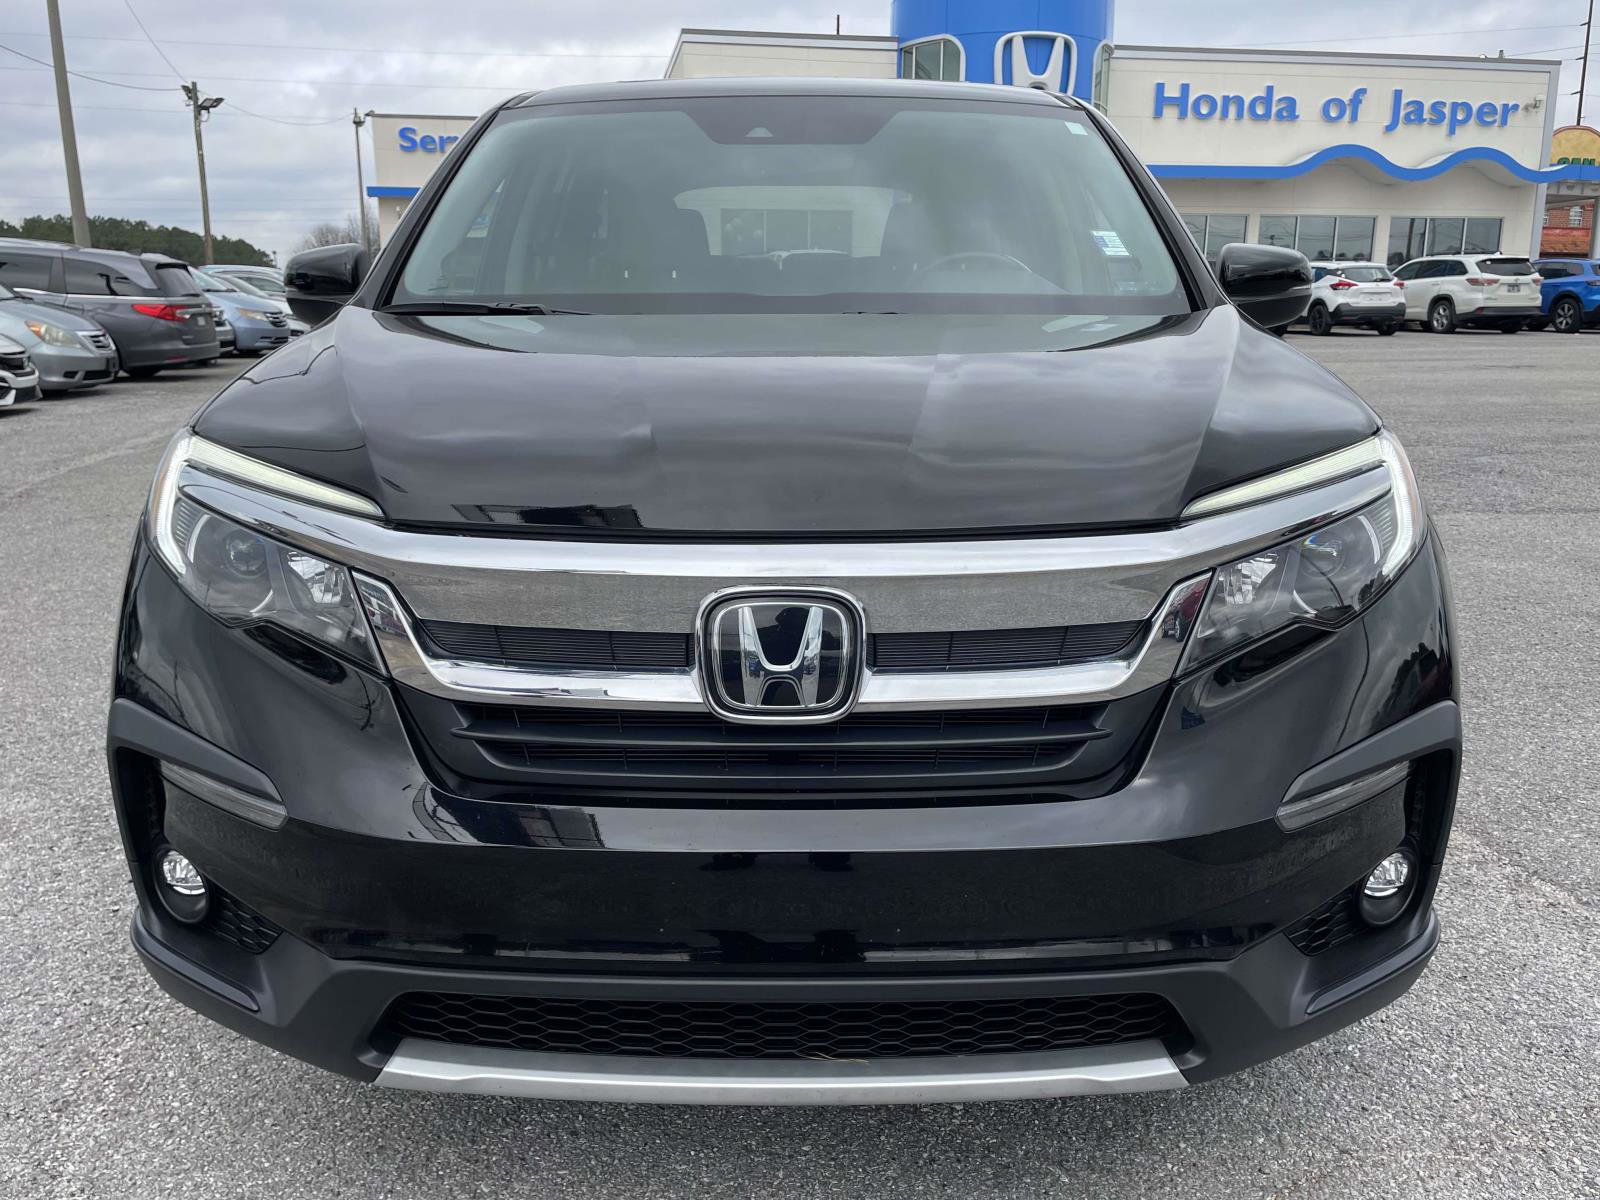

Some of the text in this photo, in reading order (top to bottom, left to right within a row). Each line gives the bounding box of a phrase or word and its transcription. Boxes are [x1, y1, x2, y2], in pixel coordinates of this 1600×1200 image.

[1153, 82, 1520, 136] Honda of Jasper
